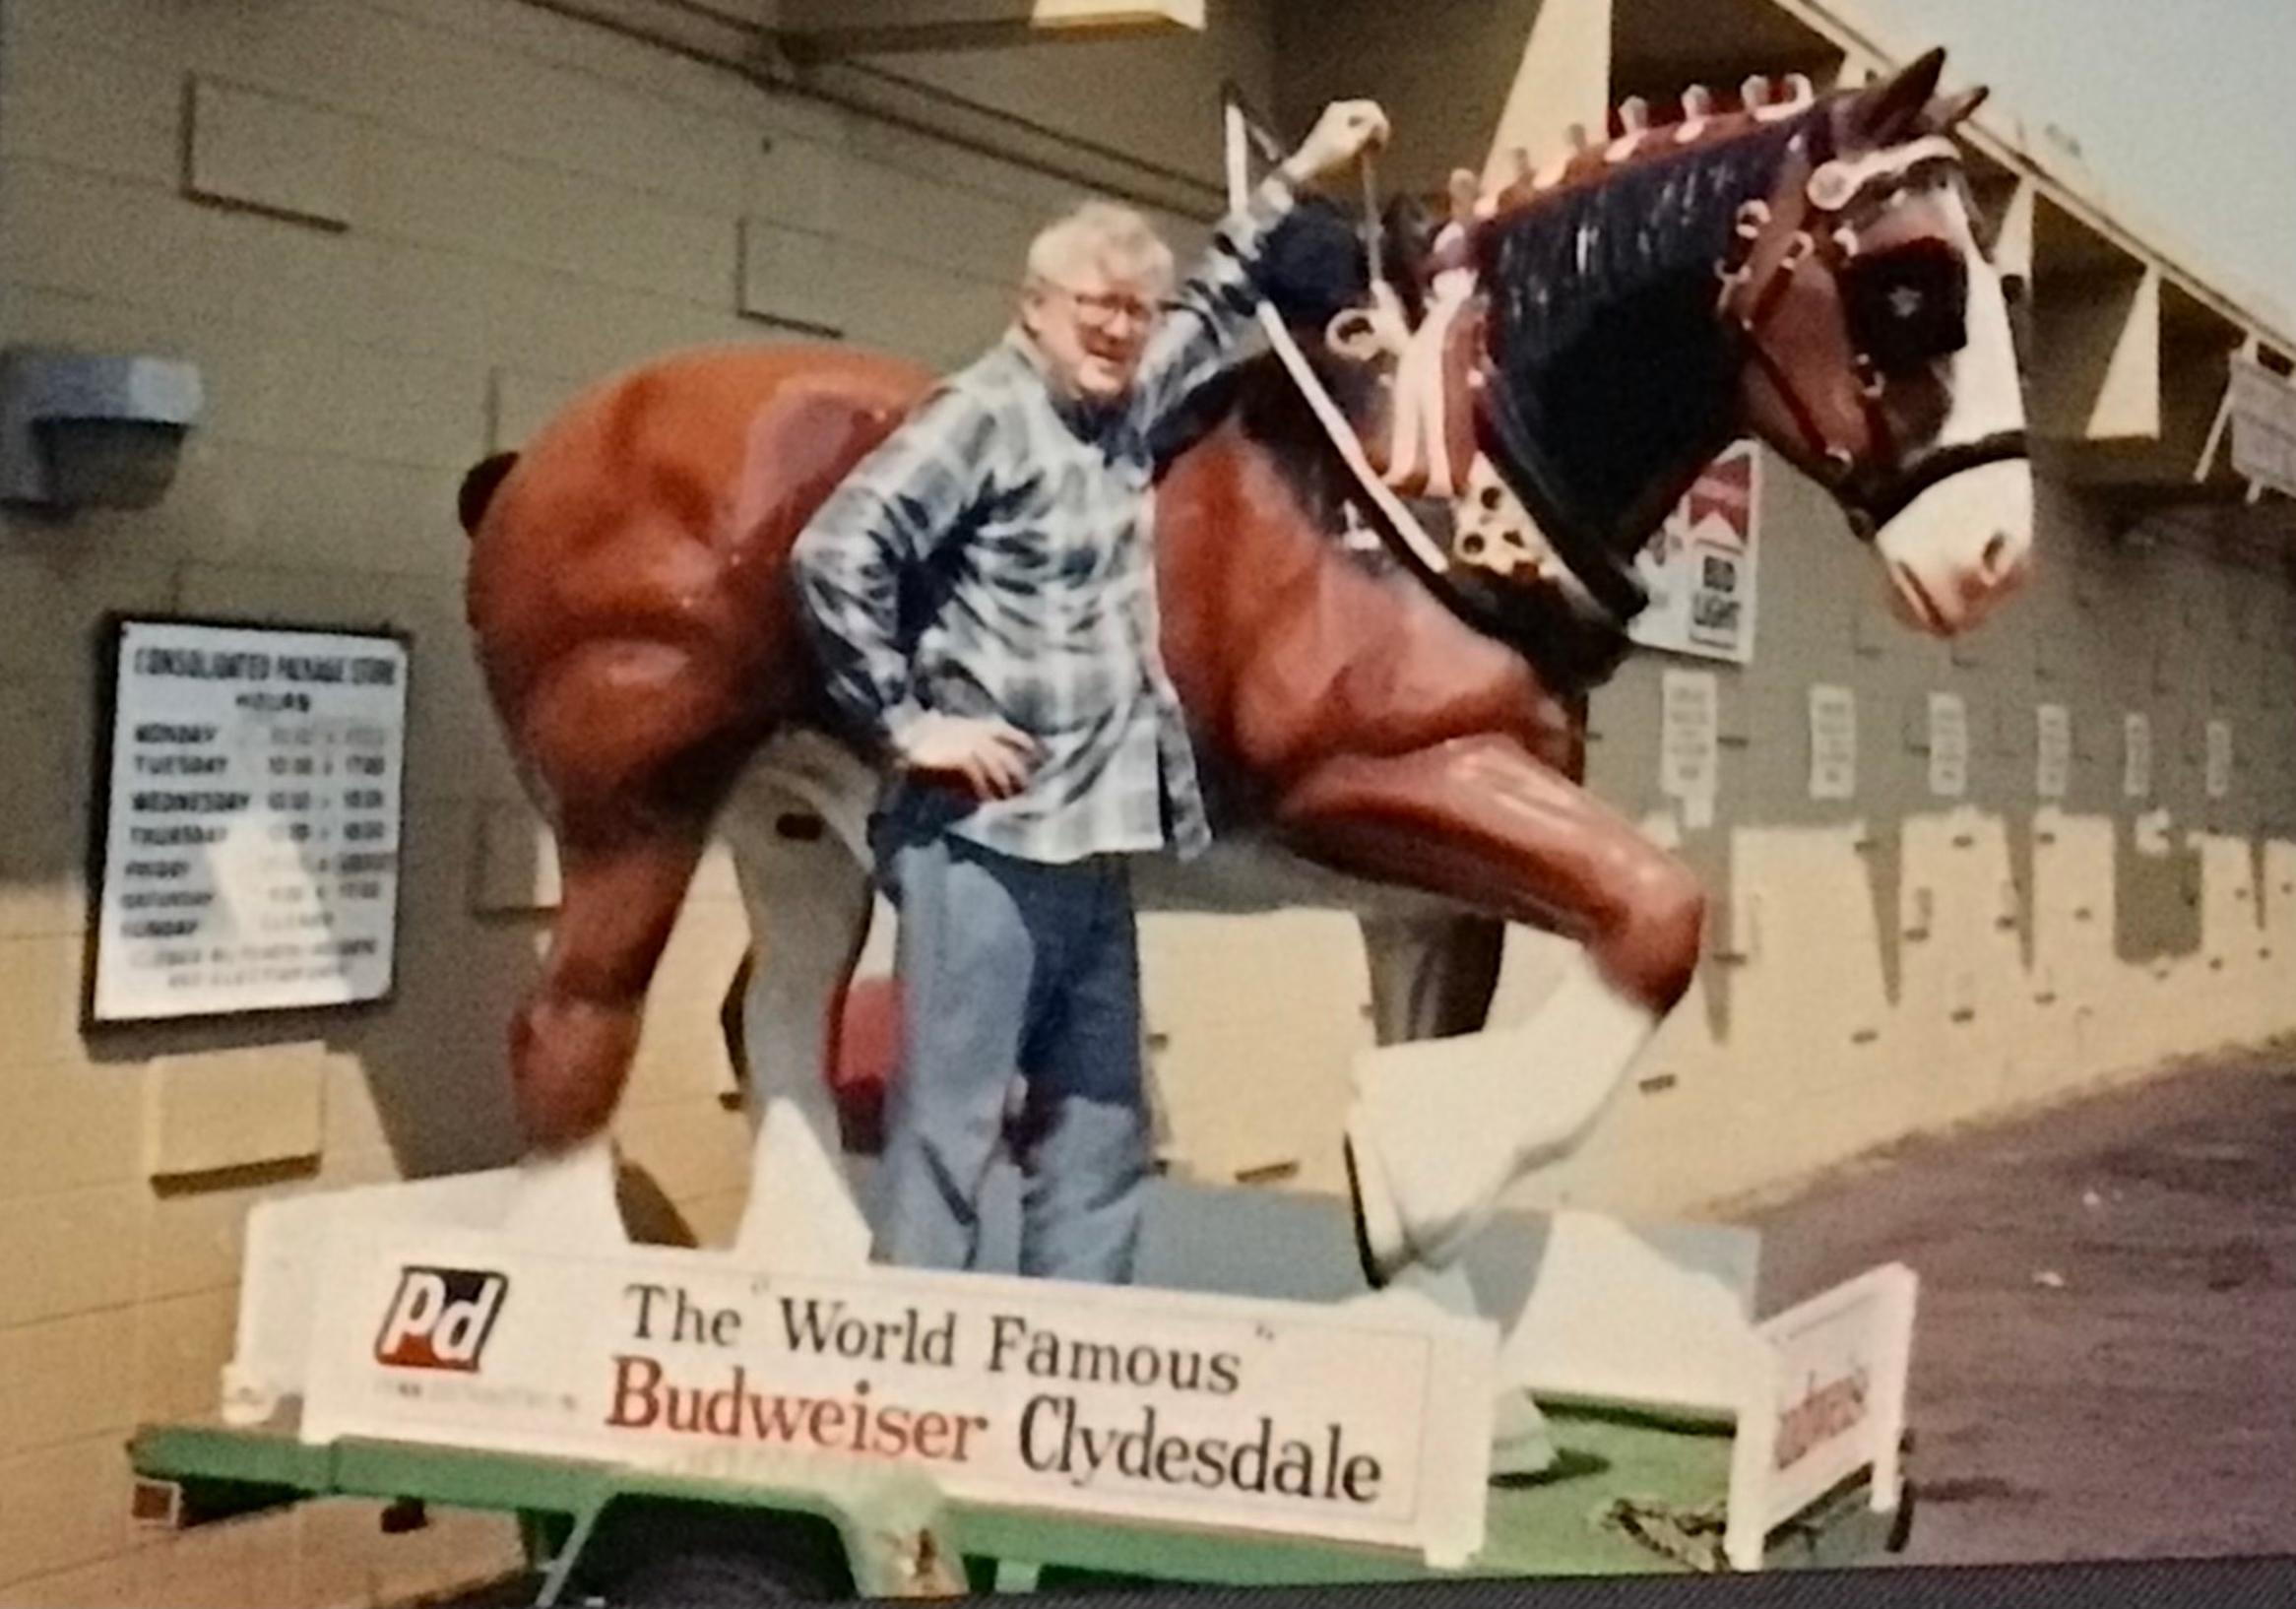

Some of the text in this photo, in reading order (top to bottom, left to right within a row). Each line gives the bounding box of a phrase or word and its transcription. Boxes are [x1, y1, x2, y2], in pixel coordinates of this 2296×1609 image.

[624, 1283, 742, 1348] The
[605, 1353, 1382, 1505] Budweiser Clydesdale
